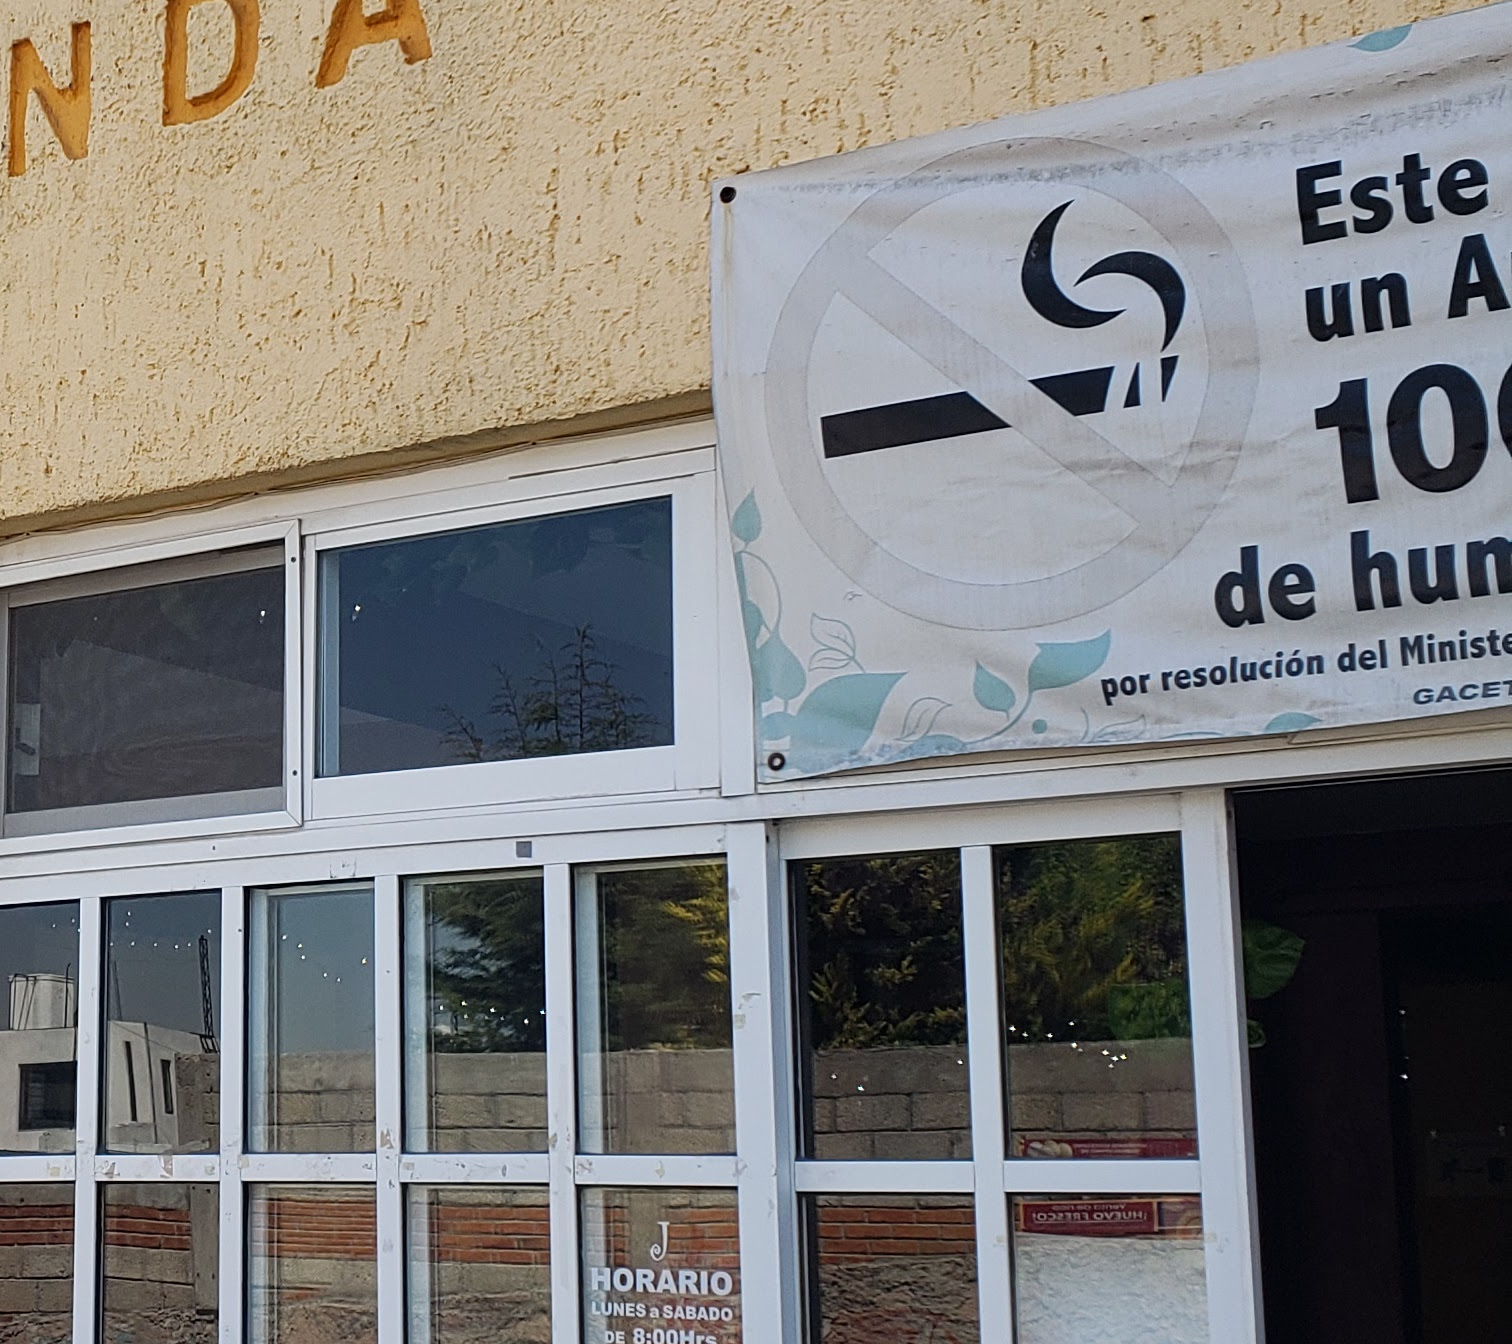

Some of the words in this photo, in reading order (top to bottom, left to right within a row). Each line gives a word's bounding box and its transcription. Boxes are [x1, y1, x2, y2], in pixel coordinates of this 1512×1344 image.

[1295, 152, 1490, 246] Este
[1304, 272, 1412, 342] un
[1447, 233, 1512, 320] A
[1314, 363, 1512, 505] 10
[1213, 544, 1317, 629] de
[1100, 672, 1150, 707] por
[1160, 649, 1325, 692] resolución
[1337, 639, 1388, 673] del
[1400, 629, 1512, 667] Ministe
[591, 1267, 733, 1297] HORARIO
[591, 1301, 646, 1318] LUNES
[650, 1306, 660, 1319] a
[663, 1305, 733, 1322] SABADO
[605, 1330, 626, 1344] DE
